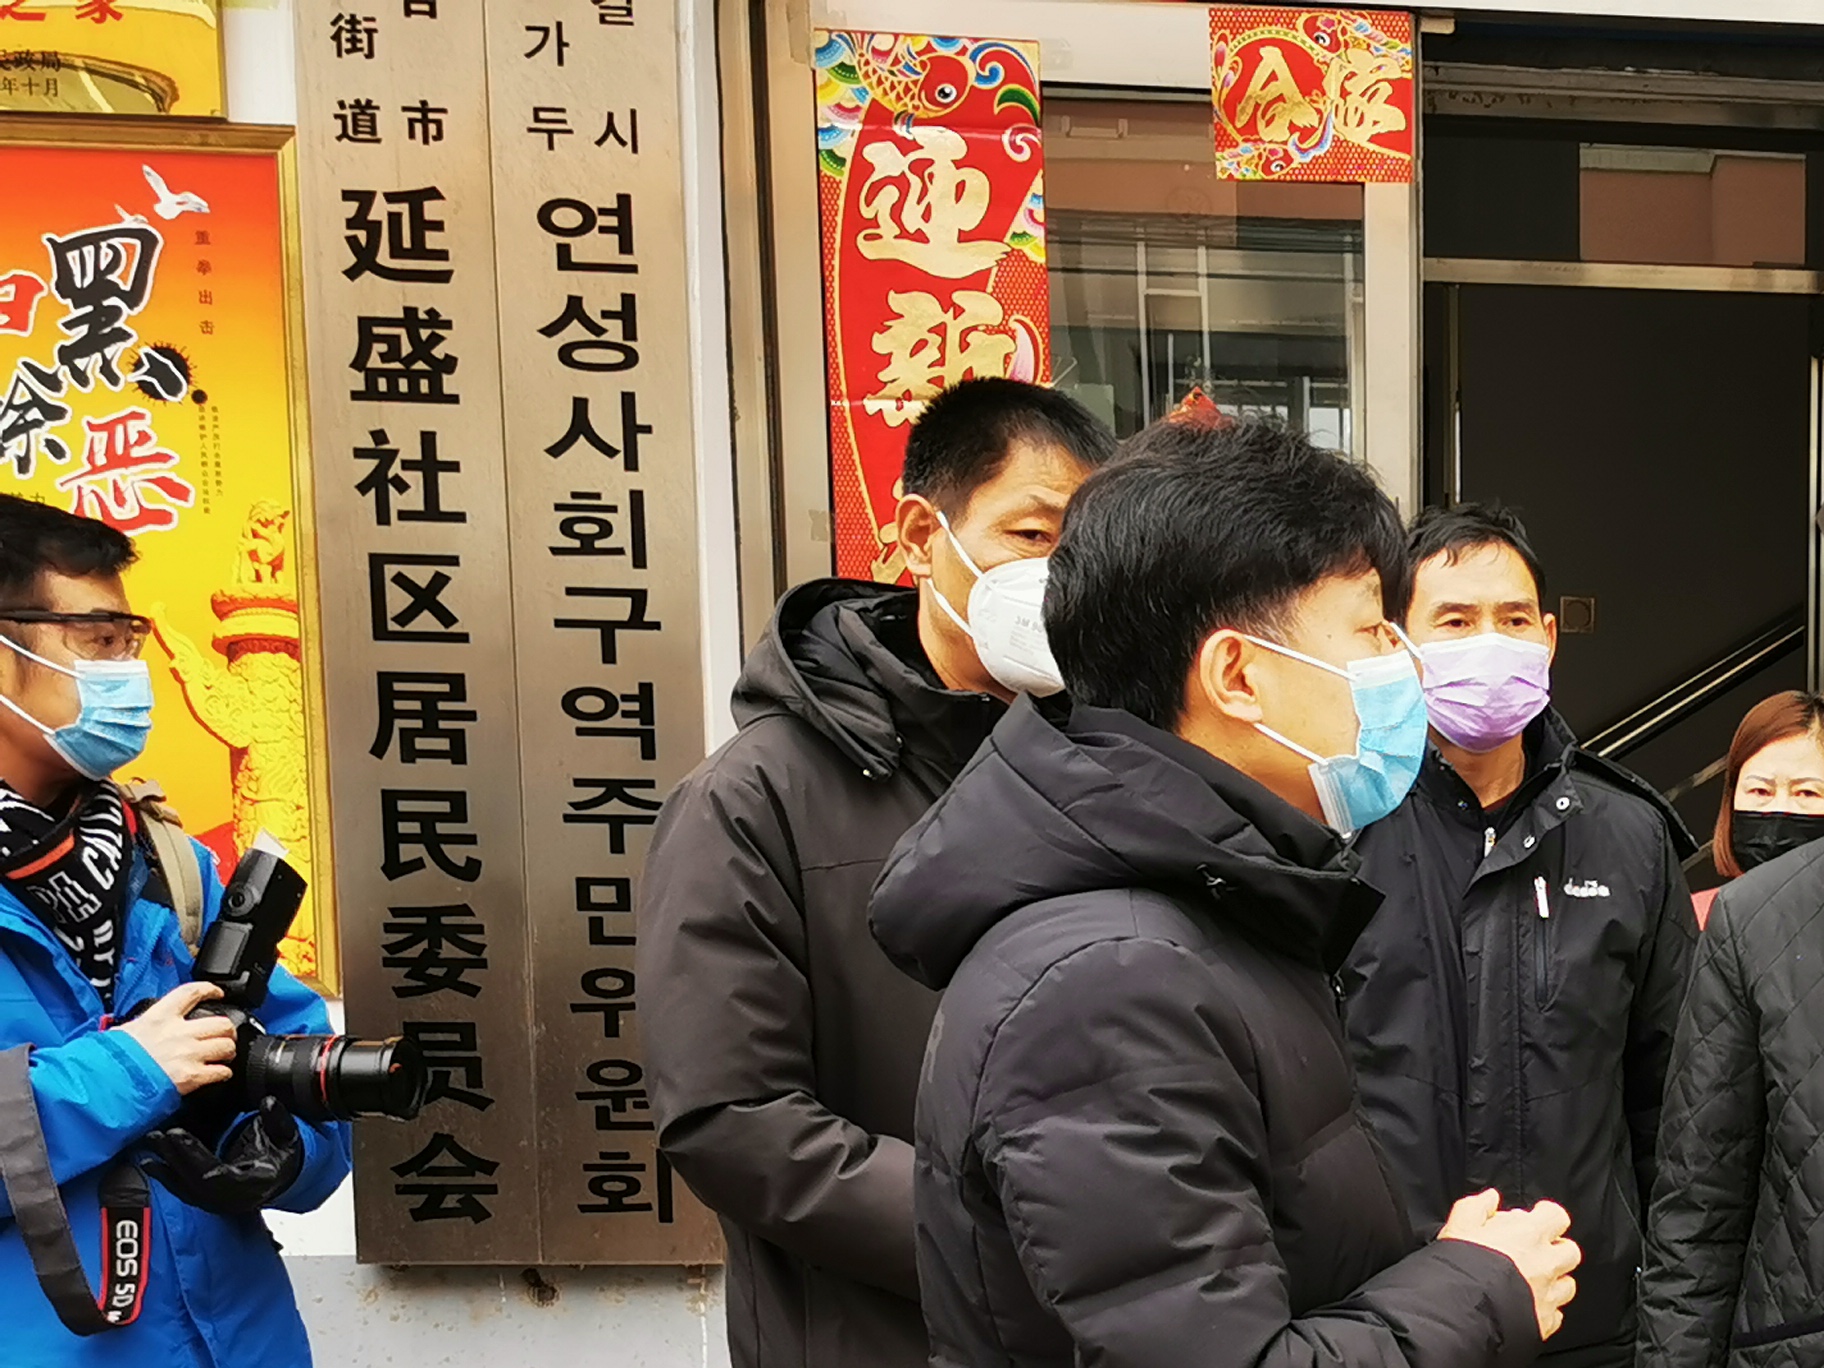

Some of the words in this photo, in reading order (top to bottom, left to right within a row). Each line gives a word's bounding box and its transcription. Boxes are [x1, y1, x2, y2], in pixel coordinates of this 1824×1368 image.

[330, 12, 383, 145] 街道
[524, 21, 575, 151] 가두
[194, 229, 215, 336] 重拳出击
[857, 126, 1016, 585] 迎新
[341, 186, 500, 1226] 延盛社区居民委员会
[111, 1283, 136, 1308] 5D
[116, 1219, 139, 1277] EOS
